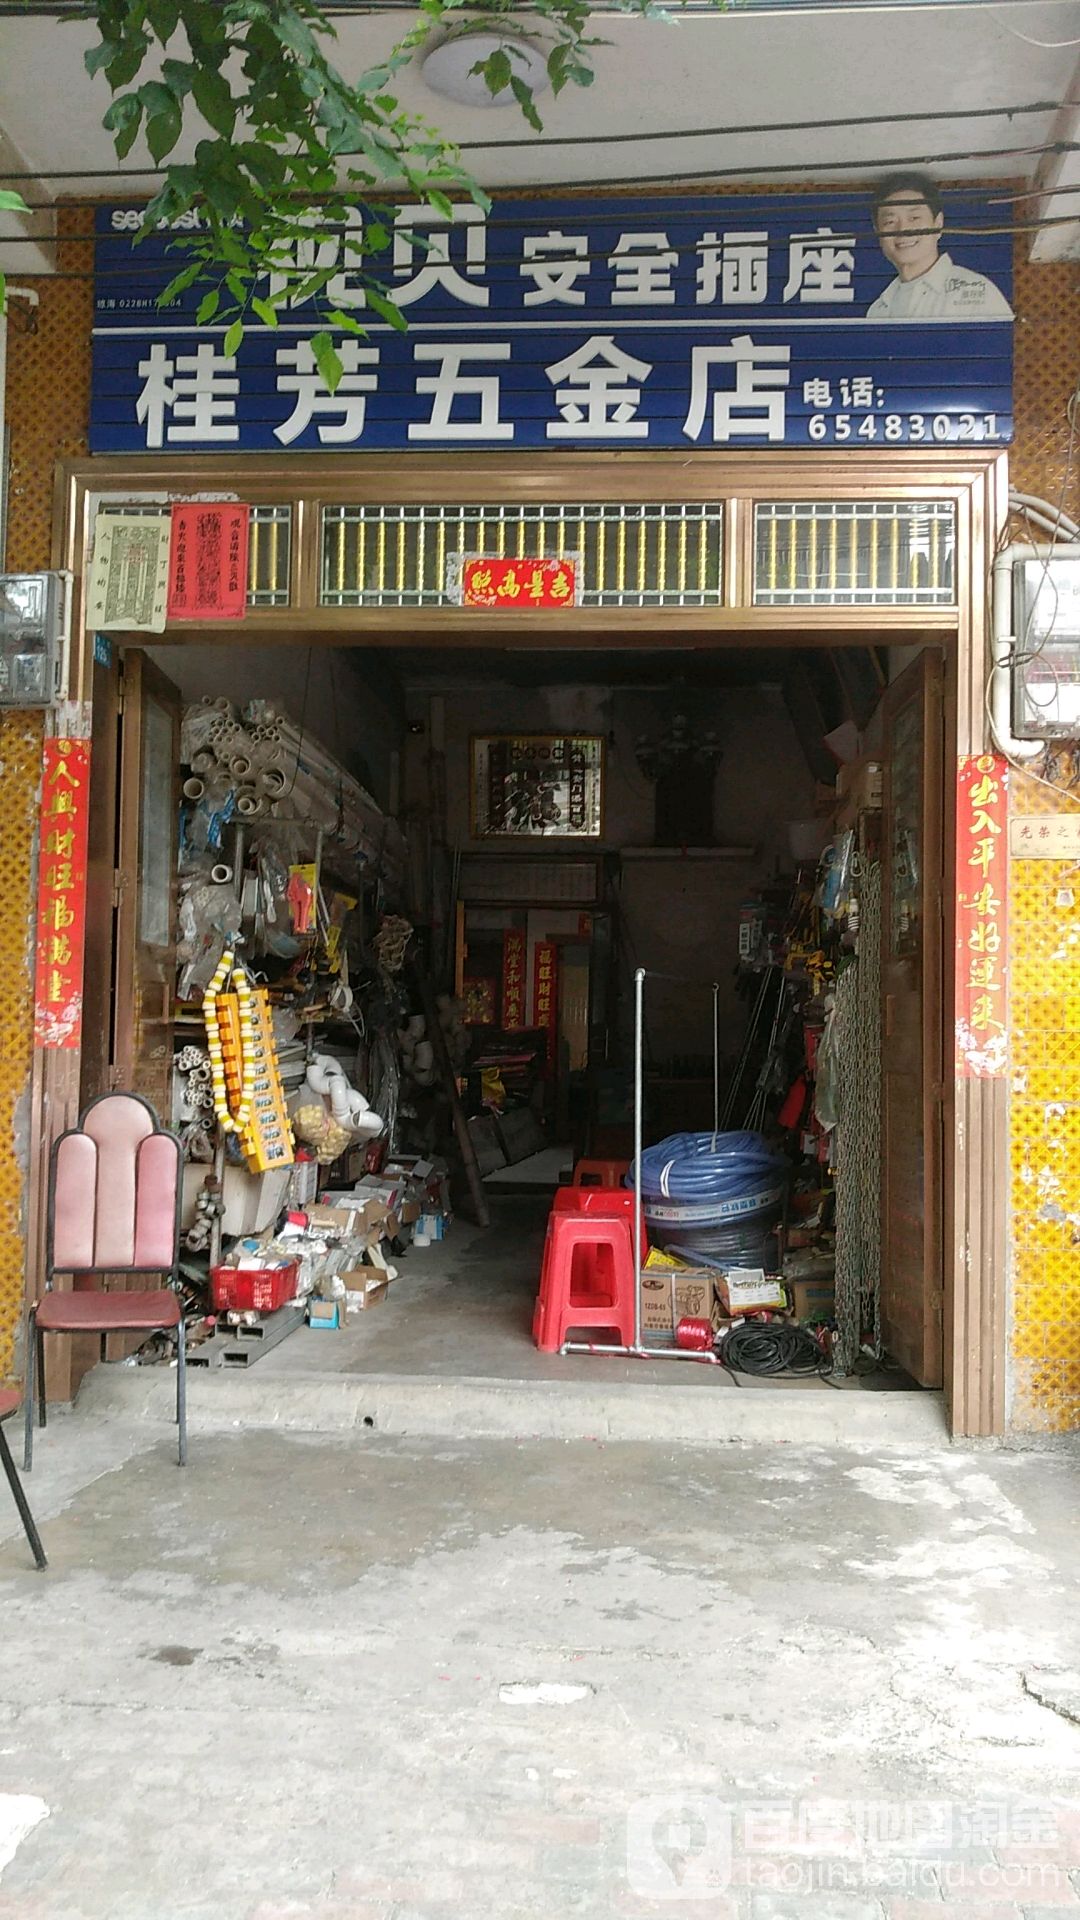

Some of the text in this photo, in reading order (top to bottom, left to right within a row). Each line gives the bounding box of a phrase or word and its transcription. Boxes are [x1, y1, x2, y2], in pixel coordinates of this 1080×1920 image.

[136, 335, 790, 449] 桂芳五金店
[809, 413, 1000, 442] 65483021
[1020, 825, 1080, 839] 光荣之
